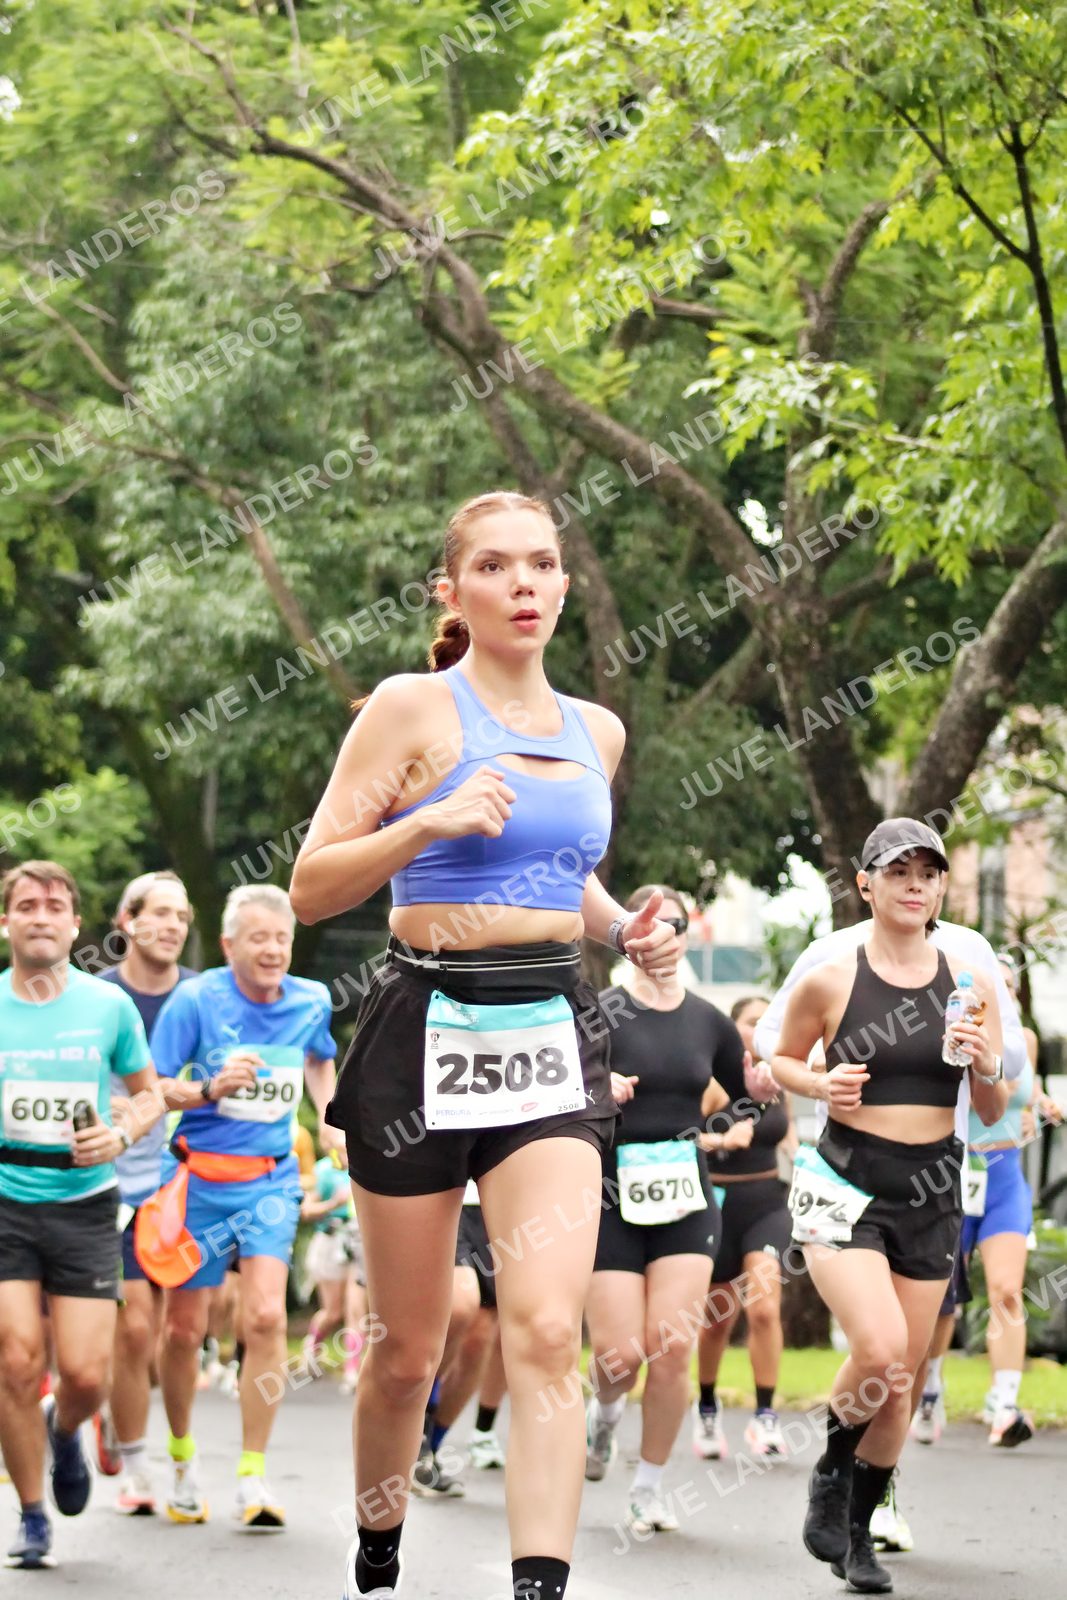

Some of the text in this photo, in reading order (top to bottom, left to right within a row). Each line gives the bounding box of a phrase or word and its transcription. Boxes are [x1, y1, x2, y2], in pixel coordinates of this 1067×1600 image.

[436, 1047, 569, 1095] 2508
[557, 1102, 580, 1113] 2508
[628, 1178, 694, 1204] 6670
